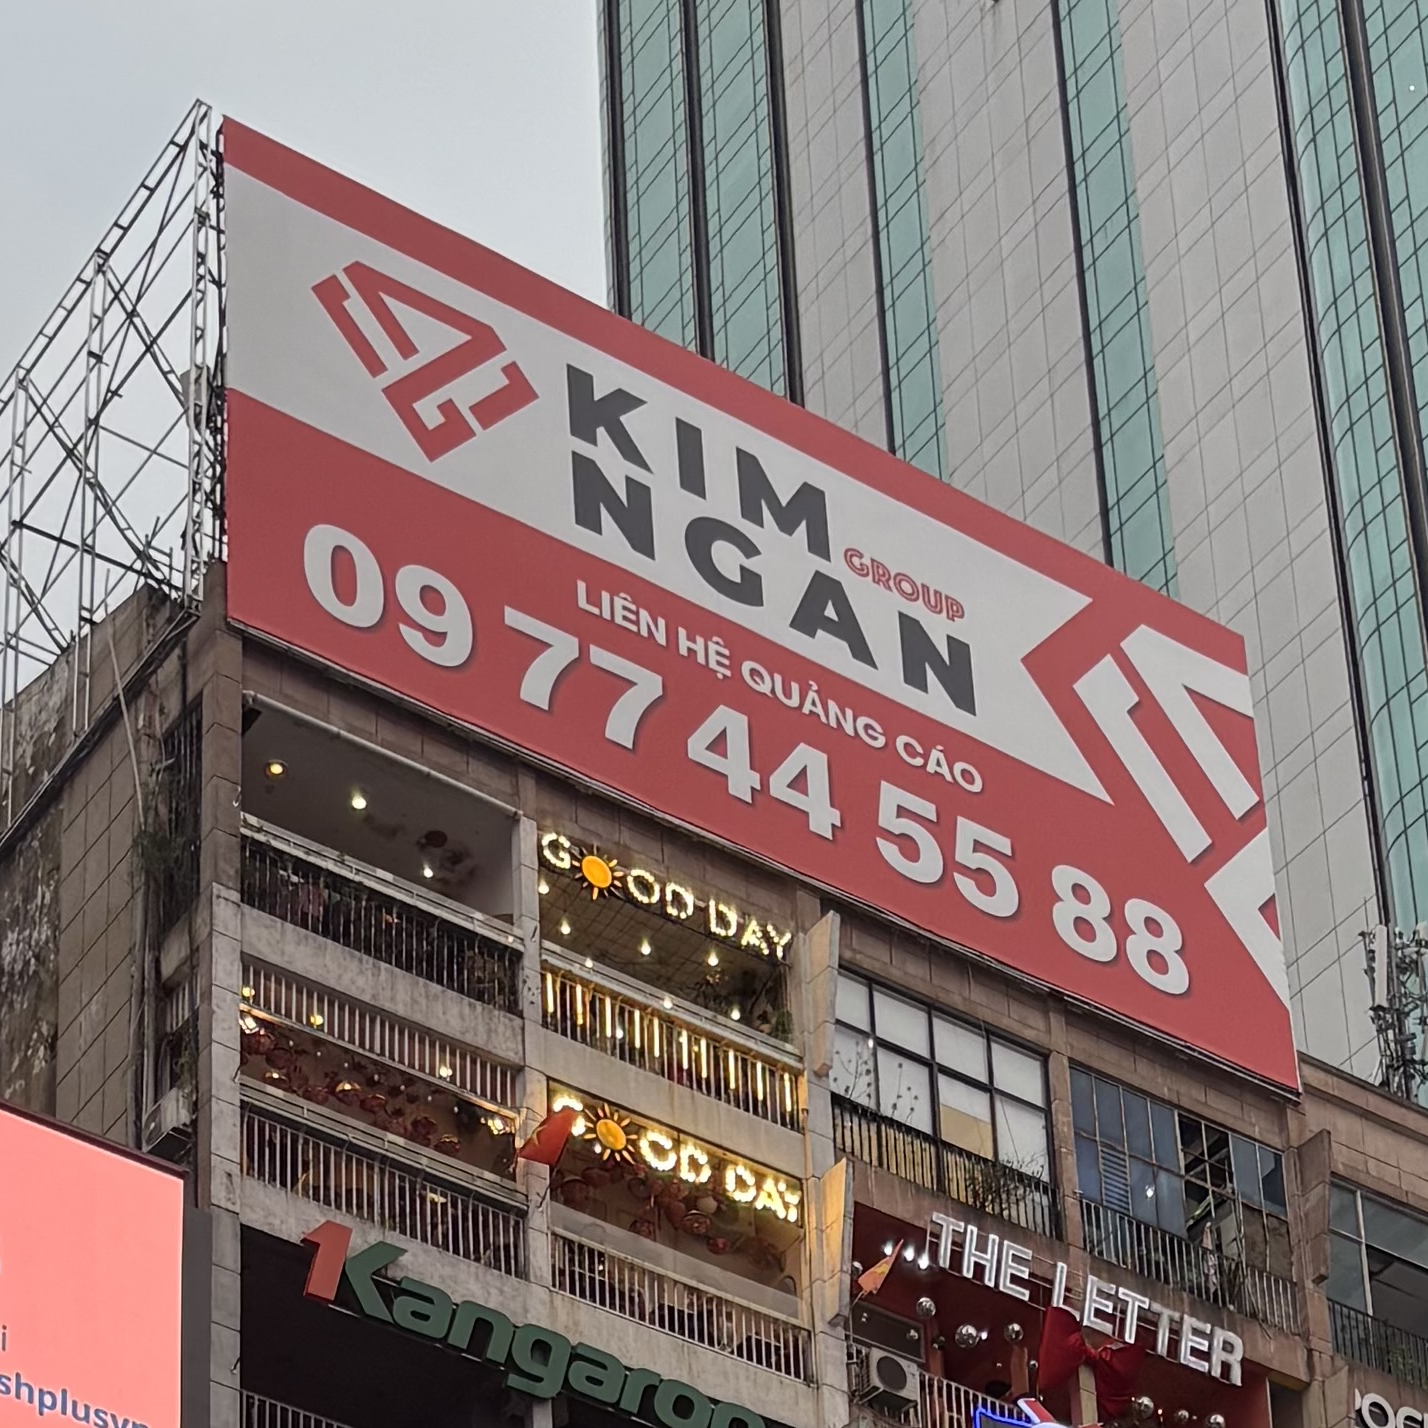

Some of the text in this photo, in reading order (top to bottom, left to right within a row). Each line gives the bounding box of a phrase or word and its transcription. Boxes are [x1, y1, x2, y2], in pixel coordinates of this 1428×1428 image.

[566, 362, 831, 561] KIM
[572, 449, 976, 716] NGAN
[844, 544, 965, 621] GROUP
[302, 523, 1190, 995] 09 77 44 55 88
[575, 580, 983, 795] LIÊN HỆ QUẢNG CÁO
[707, 897, 793, 961] DAY
[931, 1211, 1245, 1387] THE LETTER
